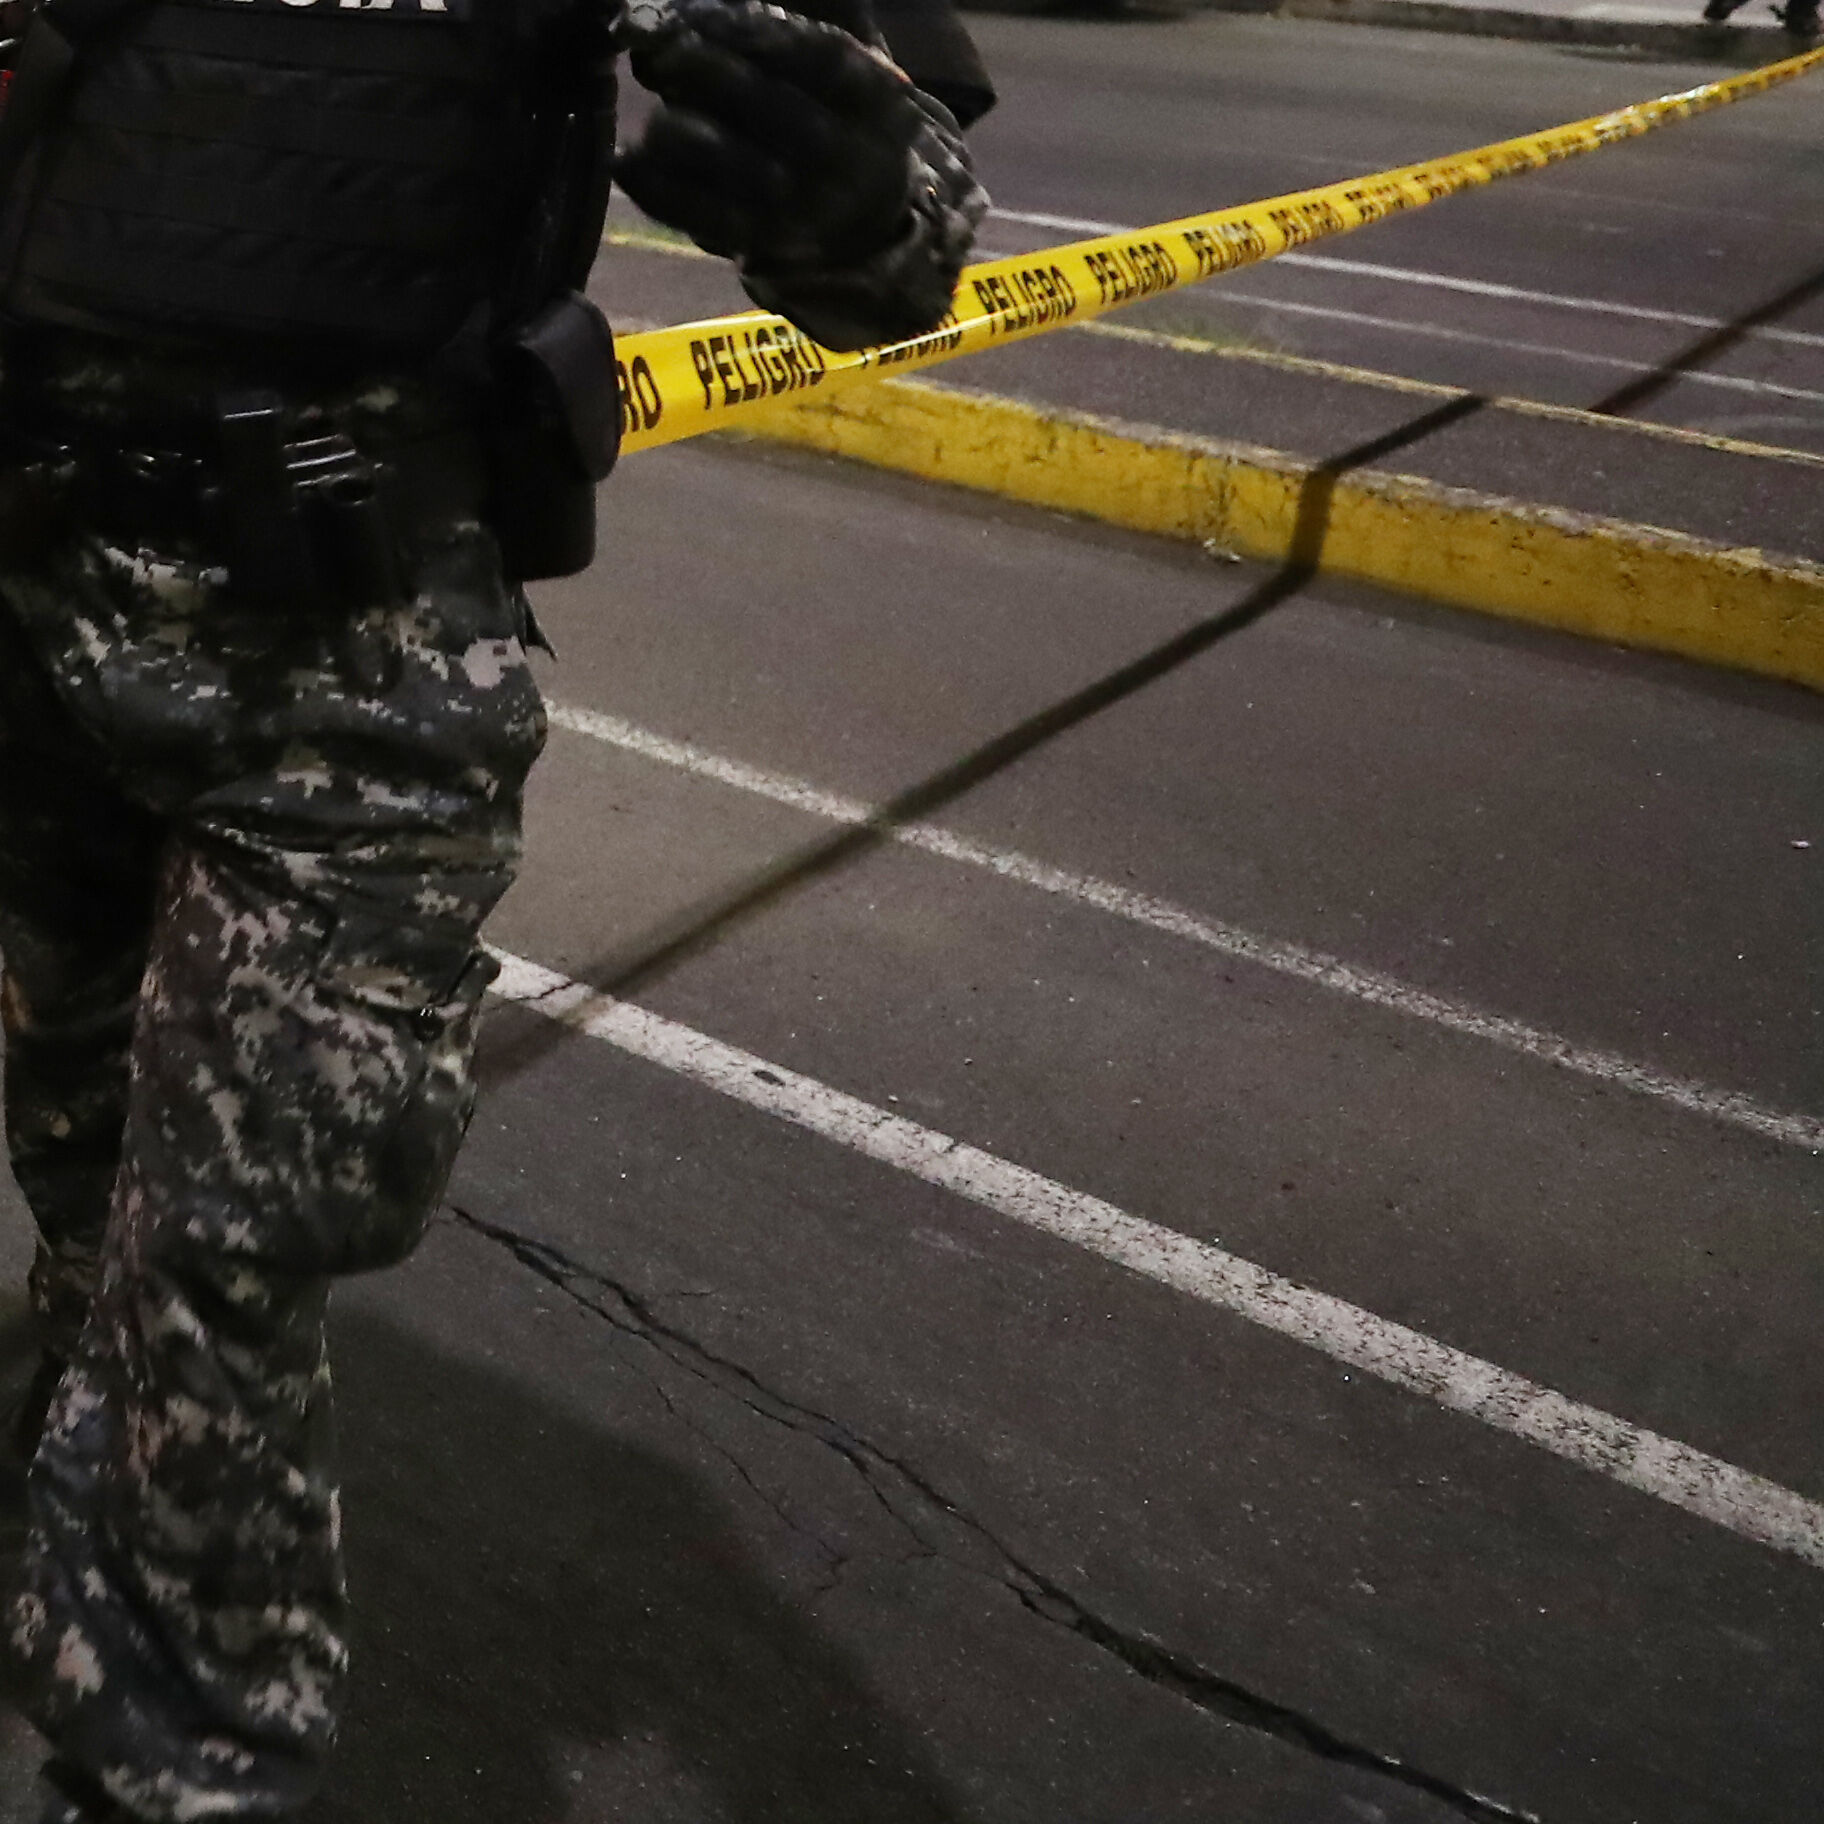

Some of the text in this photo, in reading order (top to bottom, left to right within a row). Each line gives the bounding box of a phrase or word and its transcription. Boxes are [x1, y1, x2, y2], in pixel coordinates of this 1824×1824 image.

[690, 325, 826, 412] PELIGRO
[972, 265, 1077, 337] PELIGRO
[1083, 242, 1177, 305] PELIGRO
